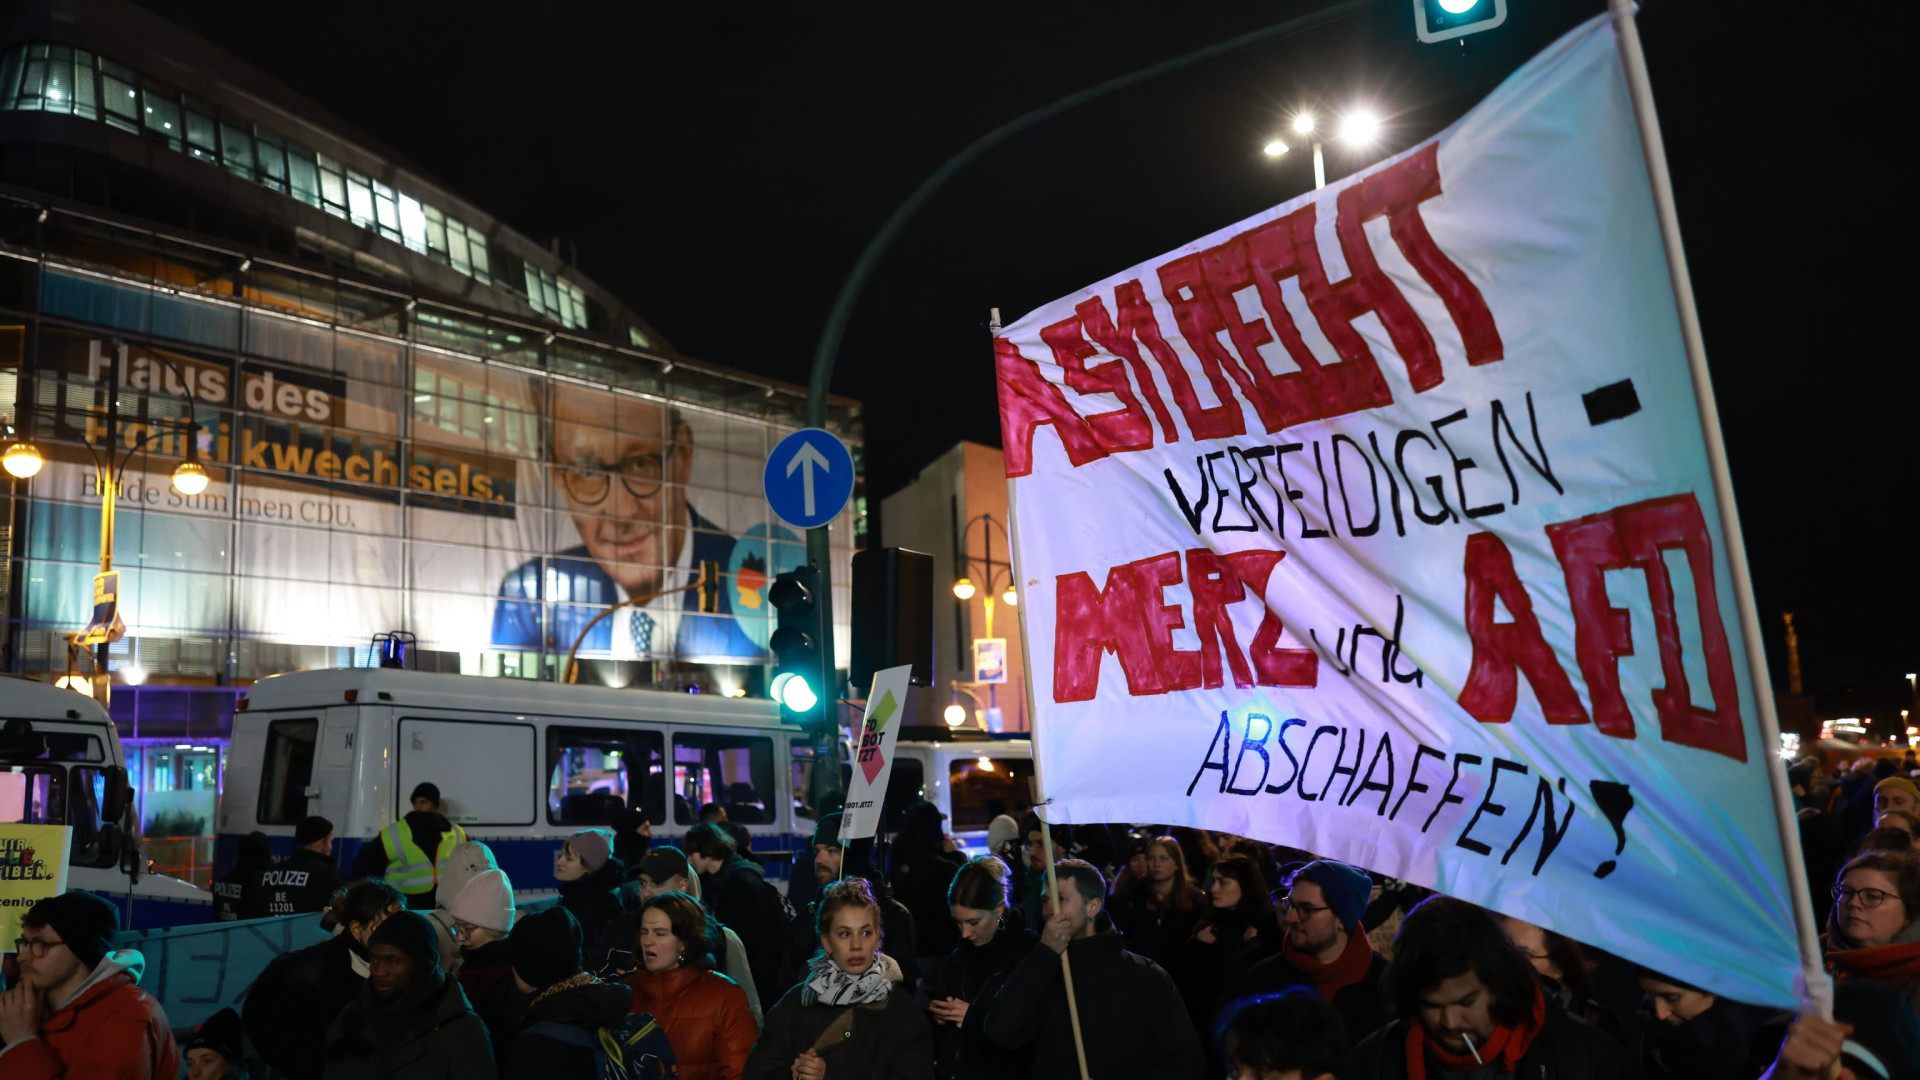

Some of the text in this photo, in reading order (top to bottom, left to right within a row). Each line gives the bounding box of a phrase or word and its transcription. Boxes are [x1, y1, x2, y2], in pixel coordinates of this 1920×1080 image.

[88, 340, 331, 421] Haus des
[1164, 391, 1565, 539] VERTEIDIGEN
[80, 472, 160, 505] Bide
[299, 498, 357, 529] CDU.
[1053, 491, 1749, 763] MERZ und AFD
[1186, 709, 1635, 880] ABSCHAFFEN!
[214, 882, 243, 900] POLIZEI
[261, 870, 310, 888] POLIZEI
[275, 892, 287, 902] BE
[269, 903, 295, 913] 11201
